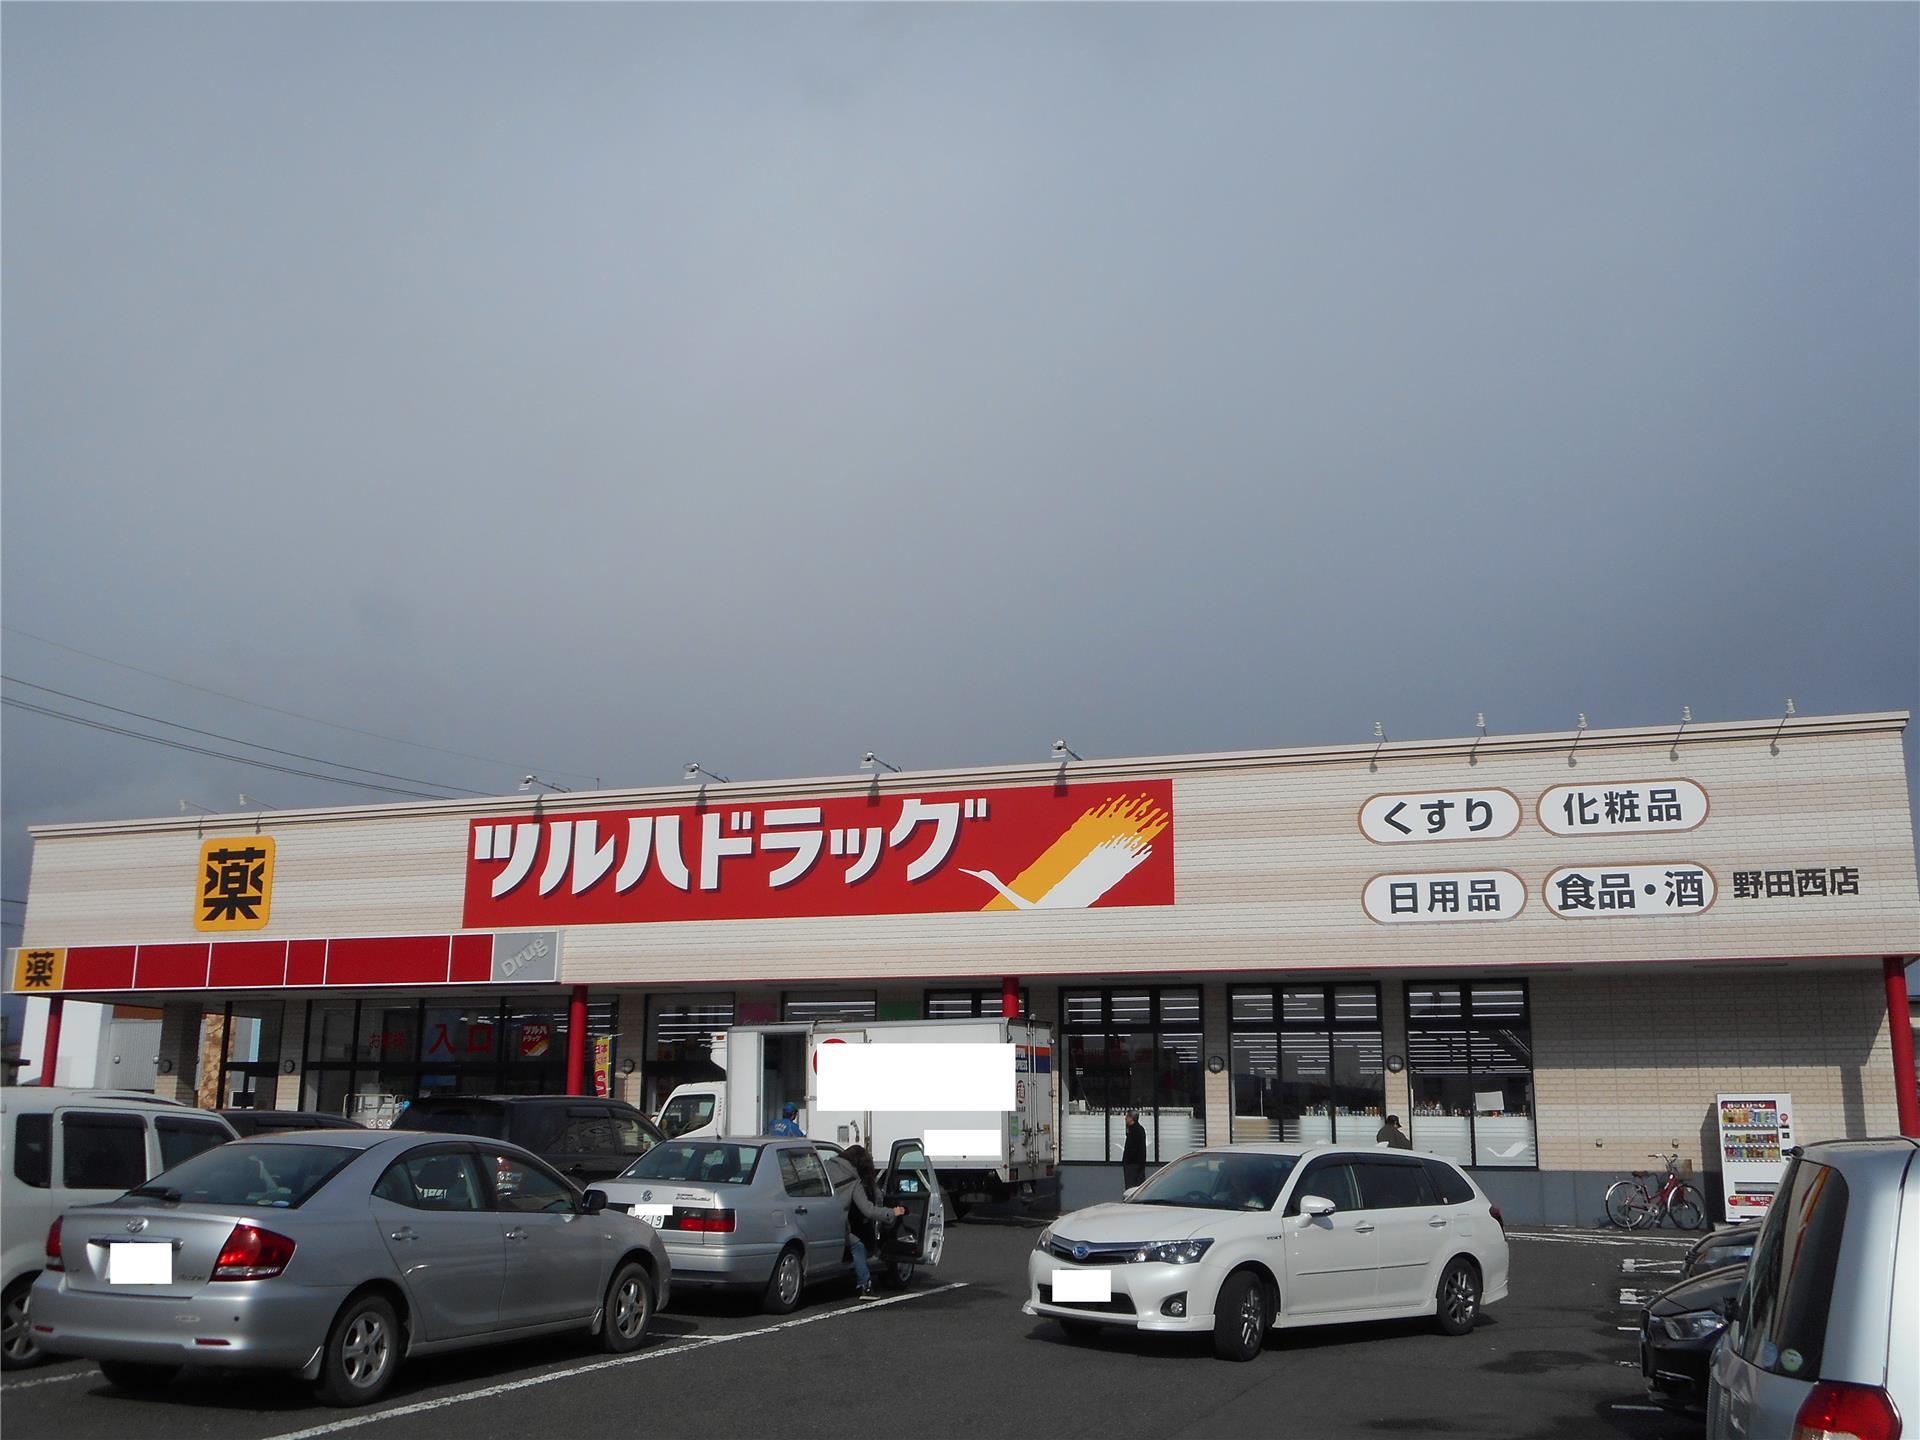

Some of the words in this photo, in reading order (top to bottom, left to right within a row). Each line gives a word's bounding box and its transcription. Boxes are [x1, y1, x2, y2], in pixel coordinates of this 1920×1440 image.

[1383, 798, 1494, 835] くすり
[1562, 788, 1683, 826] 化粧品
[473, 797, 989, 900] ツルハドラッグ
[201, 847, 267, 922] 薬
[1389, 878, 1501, 915] 日用品
[1555, 869, 1706, 911] 食品・酒
[1732, 866, 1860, 899] 野田西店
[25, 951, 55, 988] 薬
[500, 935, 549, 977] Drug
[428, 1023, 494, 1055] 入口
